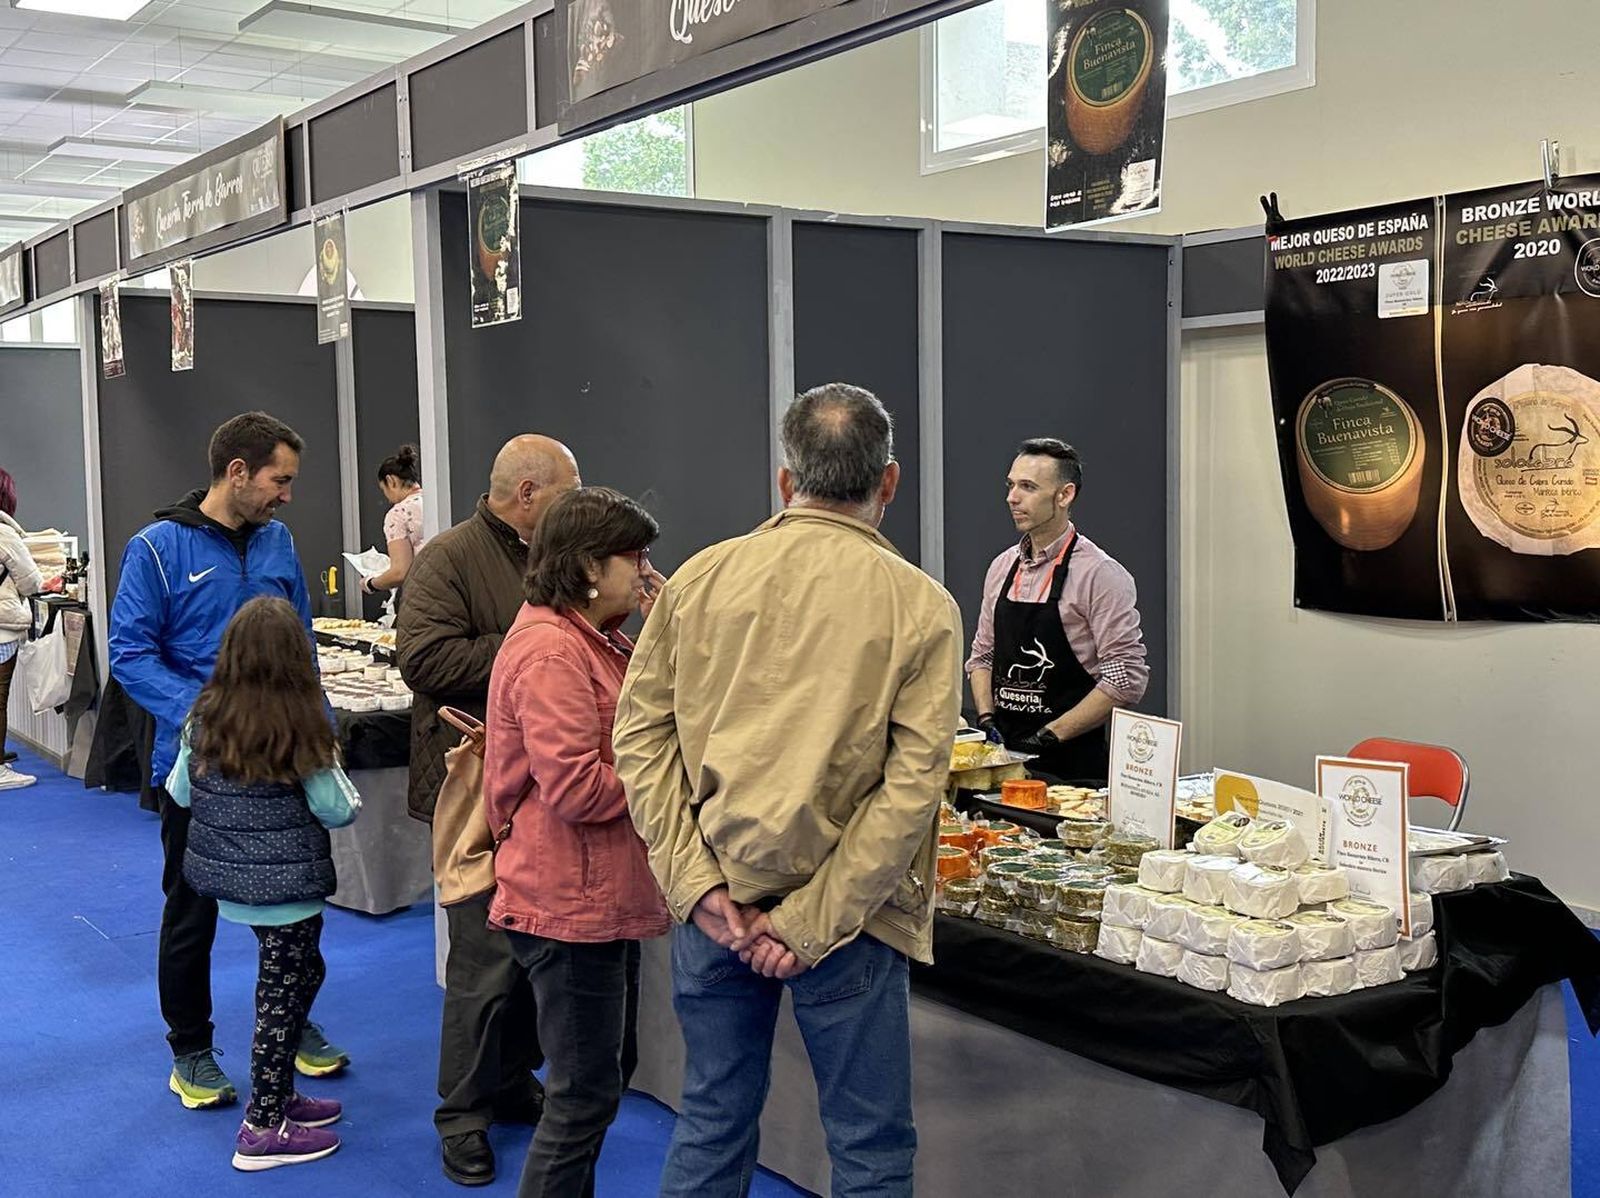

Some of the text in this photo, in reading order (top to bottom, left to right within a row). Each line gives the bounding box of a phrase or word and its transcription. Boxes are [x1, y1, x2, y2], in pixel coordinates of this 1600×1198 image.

[1083, 40, 1136, 70] Buenavista
[1095, 38, 1122, 55] Finca
[205, 179, 213, 208] de
[1461, 197, 1541, 223] BRONZE
[1271, 213, 1428, 251] MEJOR QUESO DE ESPAÑA
[1456, 213, 1600, 245] CHEESE AWAR
[1275, 236, 1423, 270] WORLD CHEESE AWARDS
[1513, 238, 1561, 259] 2020
[1316, 262, 1376, 284] 2022/2023
[1317, 423, 1394, 445] Buenavista
[1333, 416, 1372, 430] Finca
[1125, 763, 1153, 776] BRONZE
[1342, 840, 1378, 853] BRONZE
